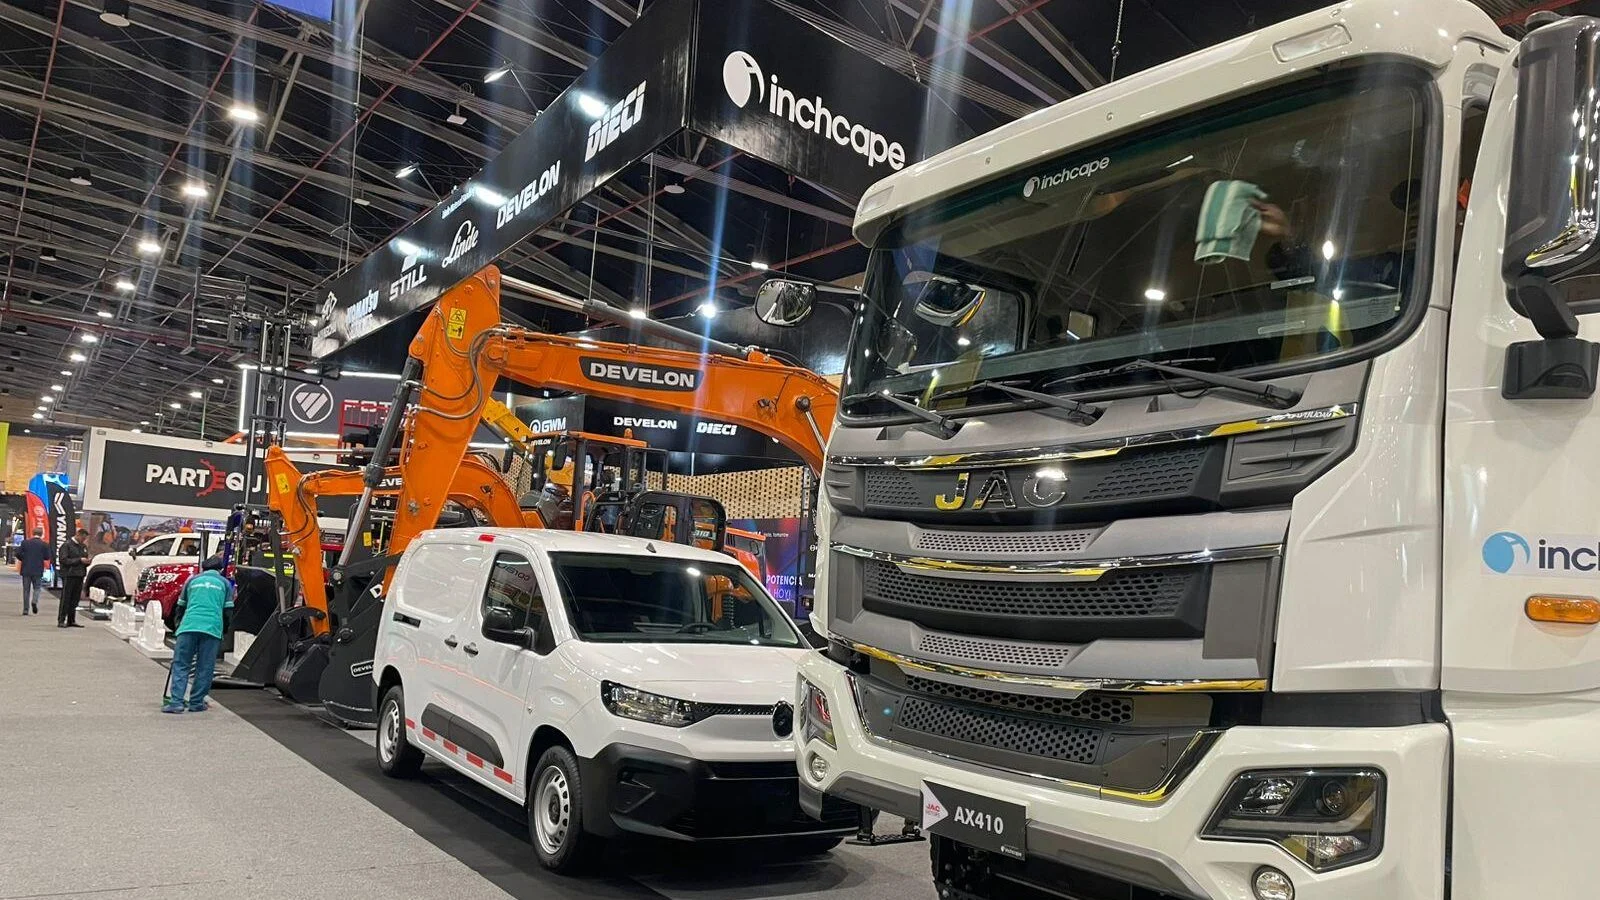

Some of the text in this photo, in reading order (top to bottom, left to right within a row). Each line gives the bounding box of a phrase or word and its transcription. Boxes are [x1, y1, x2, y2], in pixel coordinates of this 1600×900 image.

[584, 80, 647, 163] DIECI
[769, 73, 906, 171] inchcape
[1040, 156, 1110, 190] inchcape
[496, 160, 561, 230] DEVELON
[441, 219, 479, 268] Linde
[389, 264, 427, 301] STILL
[589, 362, 695, 388] DEVELON
[541, 416, 566, 433] GWM
[613, 416, 677, 430] DEVELON
[696, 421, 738, 436] DIECI
[935, 469, 1068, 511] JAC
[1538, 538, 1600, 572] inc
[766, 574, 803, 587] POTENCIA
[353, 663, 374, 673] DEVEL
[954, 806, 1004, 835] AX410
